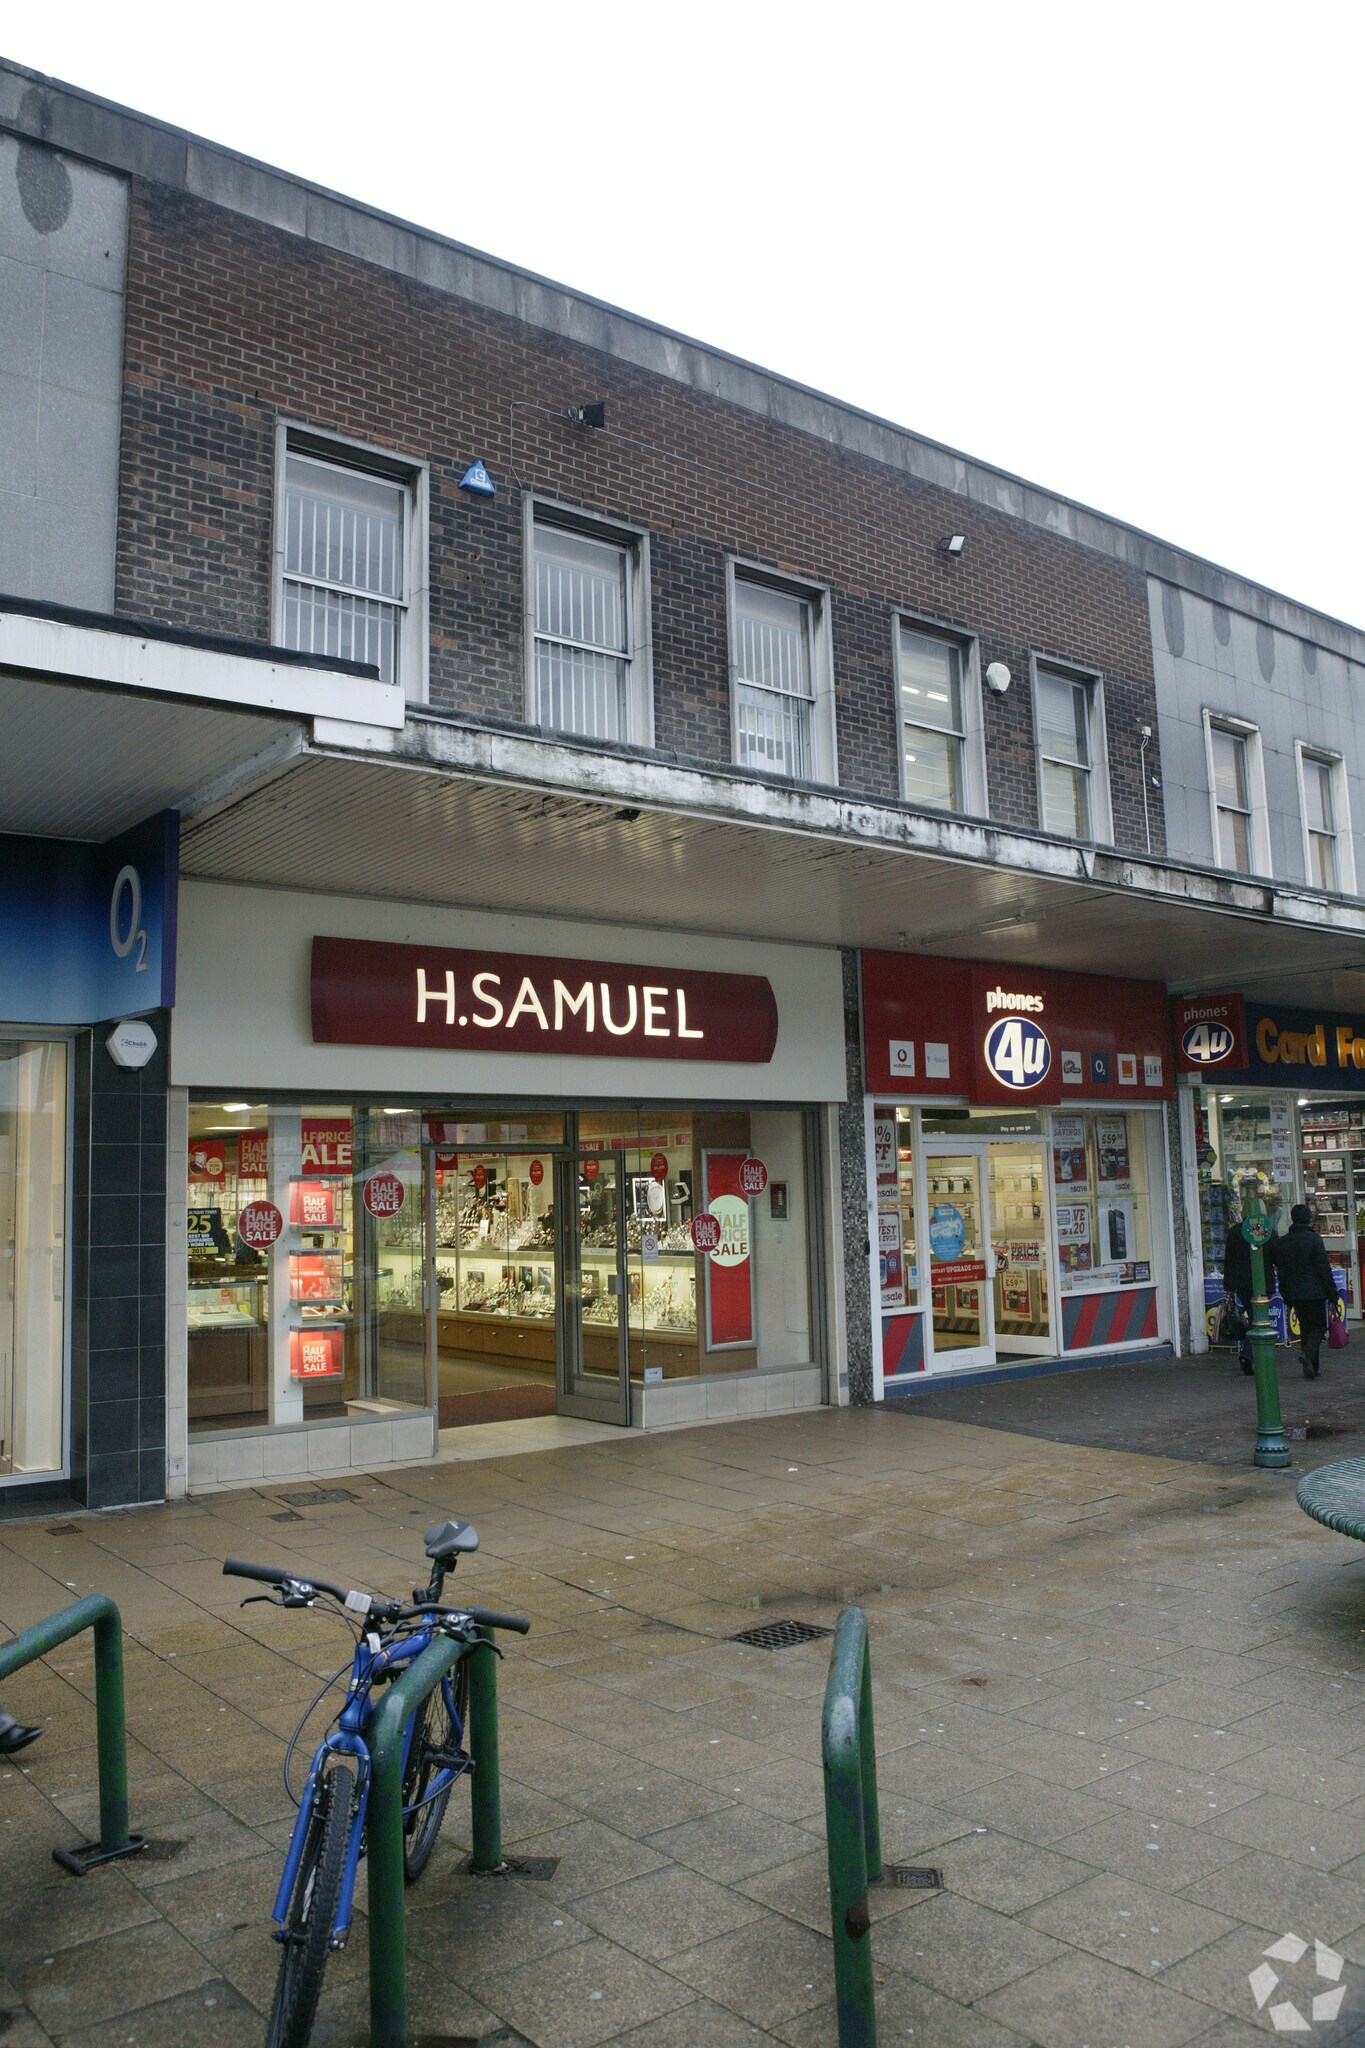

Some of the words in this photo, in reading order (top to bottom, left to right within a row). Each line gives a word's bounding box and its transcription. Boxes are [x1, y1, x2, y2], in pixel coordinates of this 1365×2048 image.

[110, 865, 148, 973] O2
[416, 968, 704, 1039] H.SAMUEL
[986, 986, 1044, 1013] phones
[1184, 1006, 1228, 1023] phones
[1187, 1025, 1227, 1060] 4u
[1256, 1018, 1327, 1067] Card
[994, 1022, 1045, 1084] 4u
[1054, 1128, 1081, 1136] SAVINGS
[302, 1143, 352, 1165] ALE
[743, 1165, 763, 1175] HALF
[743, 1175, 764, 1183] PRICE
[370, 1181, 399, 1192] HALF
[744, 1183, 764, 1191] SALE
[370, 1192, 399, 1201] PRICE
[882, 1188, 898, 1198] sale
[303, 1196, 326, 1206] HALF
[370, 1201, 400, 1211] SALE
[246, 1209, 277, 1222] HALF
[304, 1214, 328, 1222] SALE
[1071, 1208, 1086, 1221] VE
[246, 1221, 277, 1231] PRICE
[695, 1221, 717, 1231] HALF
[720, 1214, 746, 1228] ALF
[246, 1231, 278, 1241] SALE
[695, 1230, 717, 1239] PRICE
[696, 1238, 718, 1247] SALE
[1011, 1247, 1040, 1256] PRICE
[946, 1264, 972, 1273] UPGRADE
[886, 1291, 903, 1301] sale
[302, 1345, 326, 1355] HALF
[303, 1354, 326, 1363] PRICE
[303, 1363, 327, 1373] SALE
